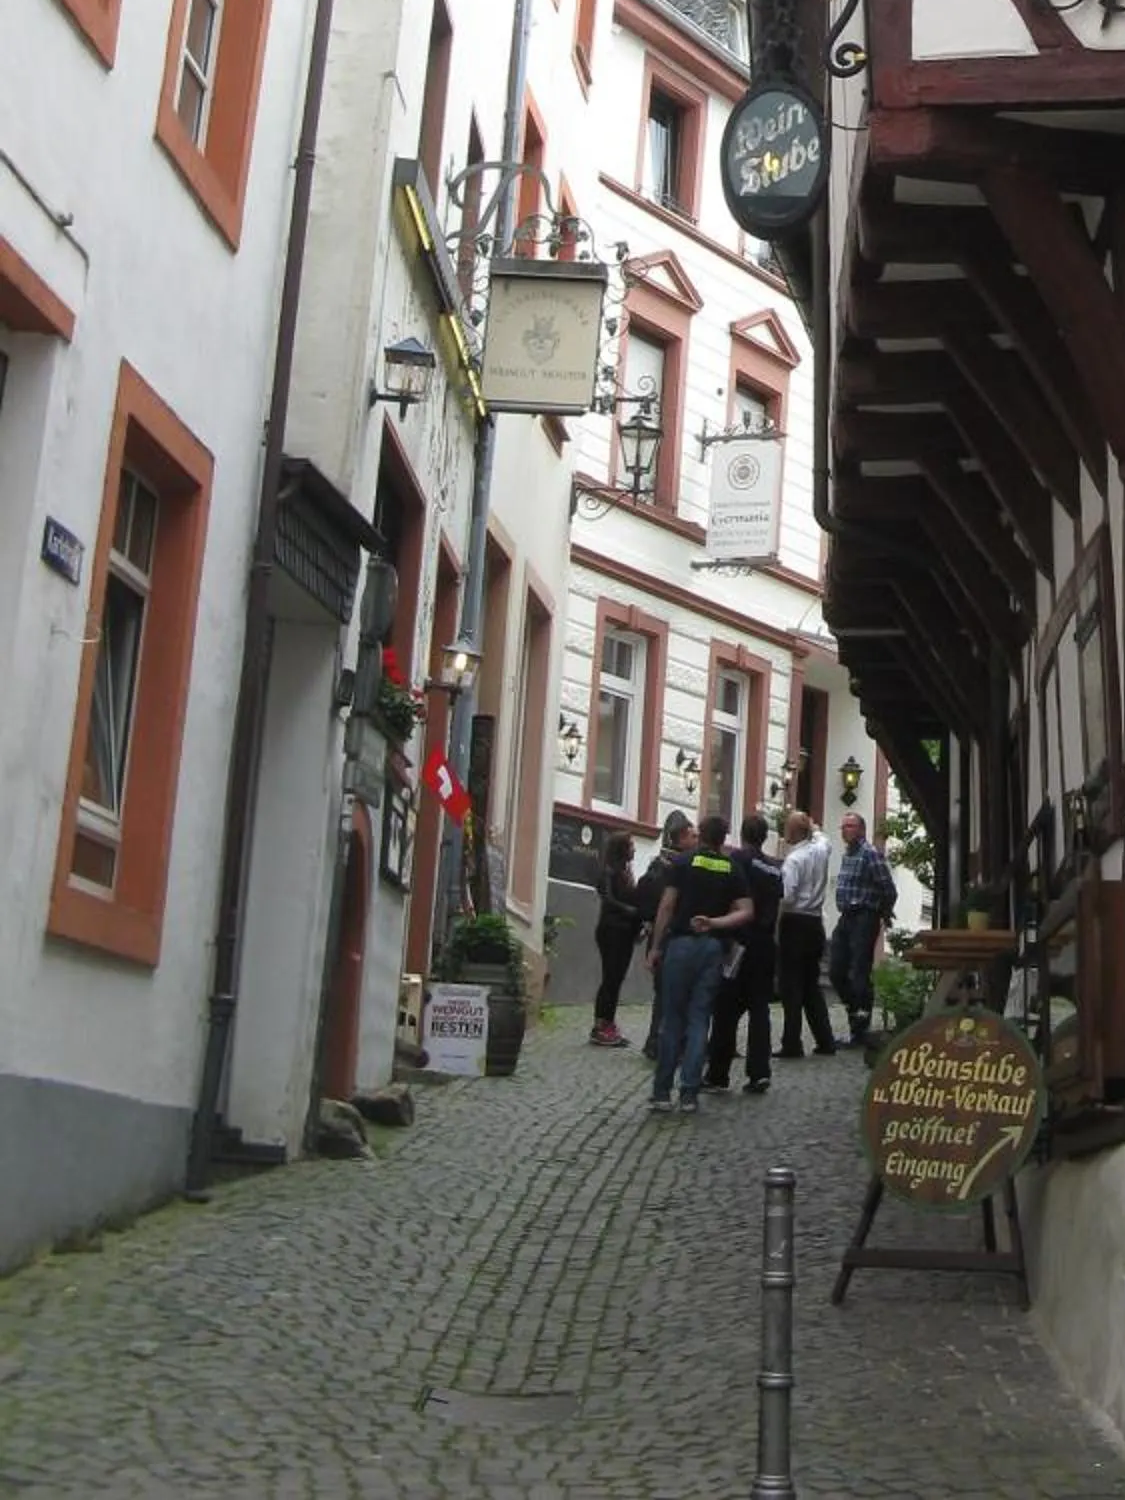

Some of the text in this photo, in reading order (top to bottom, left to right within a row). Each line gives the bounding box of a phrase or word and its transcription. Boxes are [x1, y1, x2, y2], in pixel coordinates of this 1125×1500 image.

[739, 136, 821, 197] Stube
[431, 1021, 483, 1035] BESTEN
[432, 1004, 484, 1017] WEINGUT
[891, 1043, 1028, 1086] Weinstube
[873, 1077, 1037, 1120] u. Wein-Verkauf
[881, 1115, 982, 1146] geöffnet
[884, 1150, 967, 1194] Eingang
